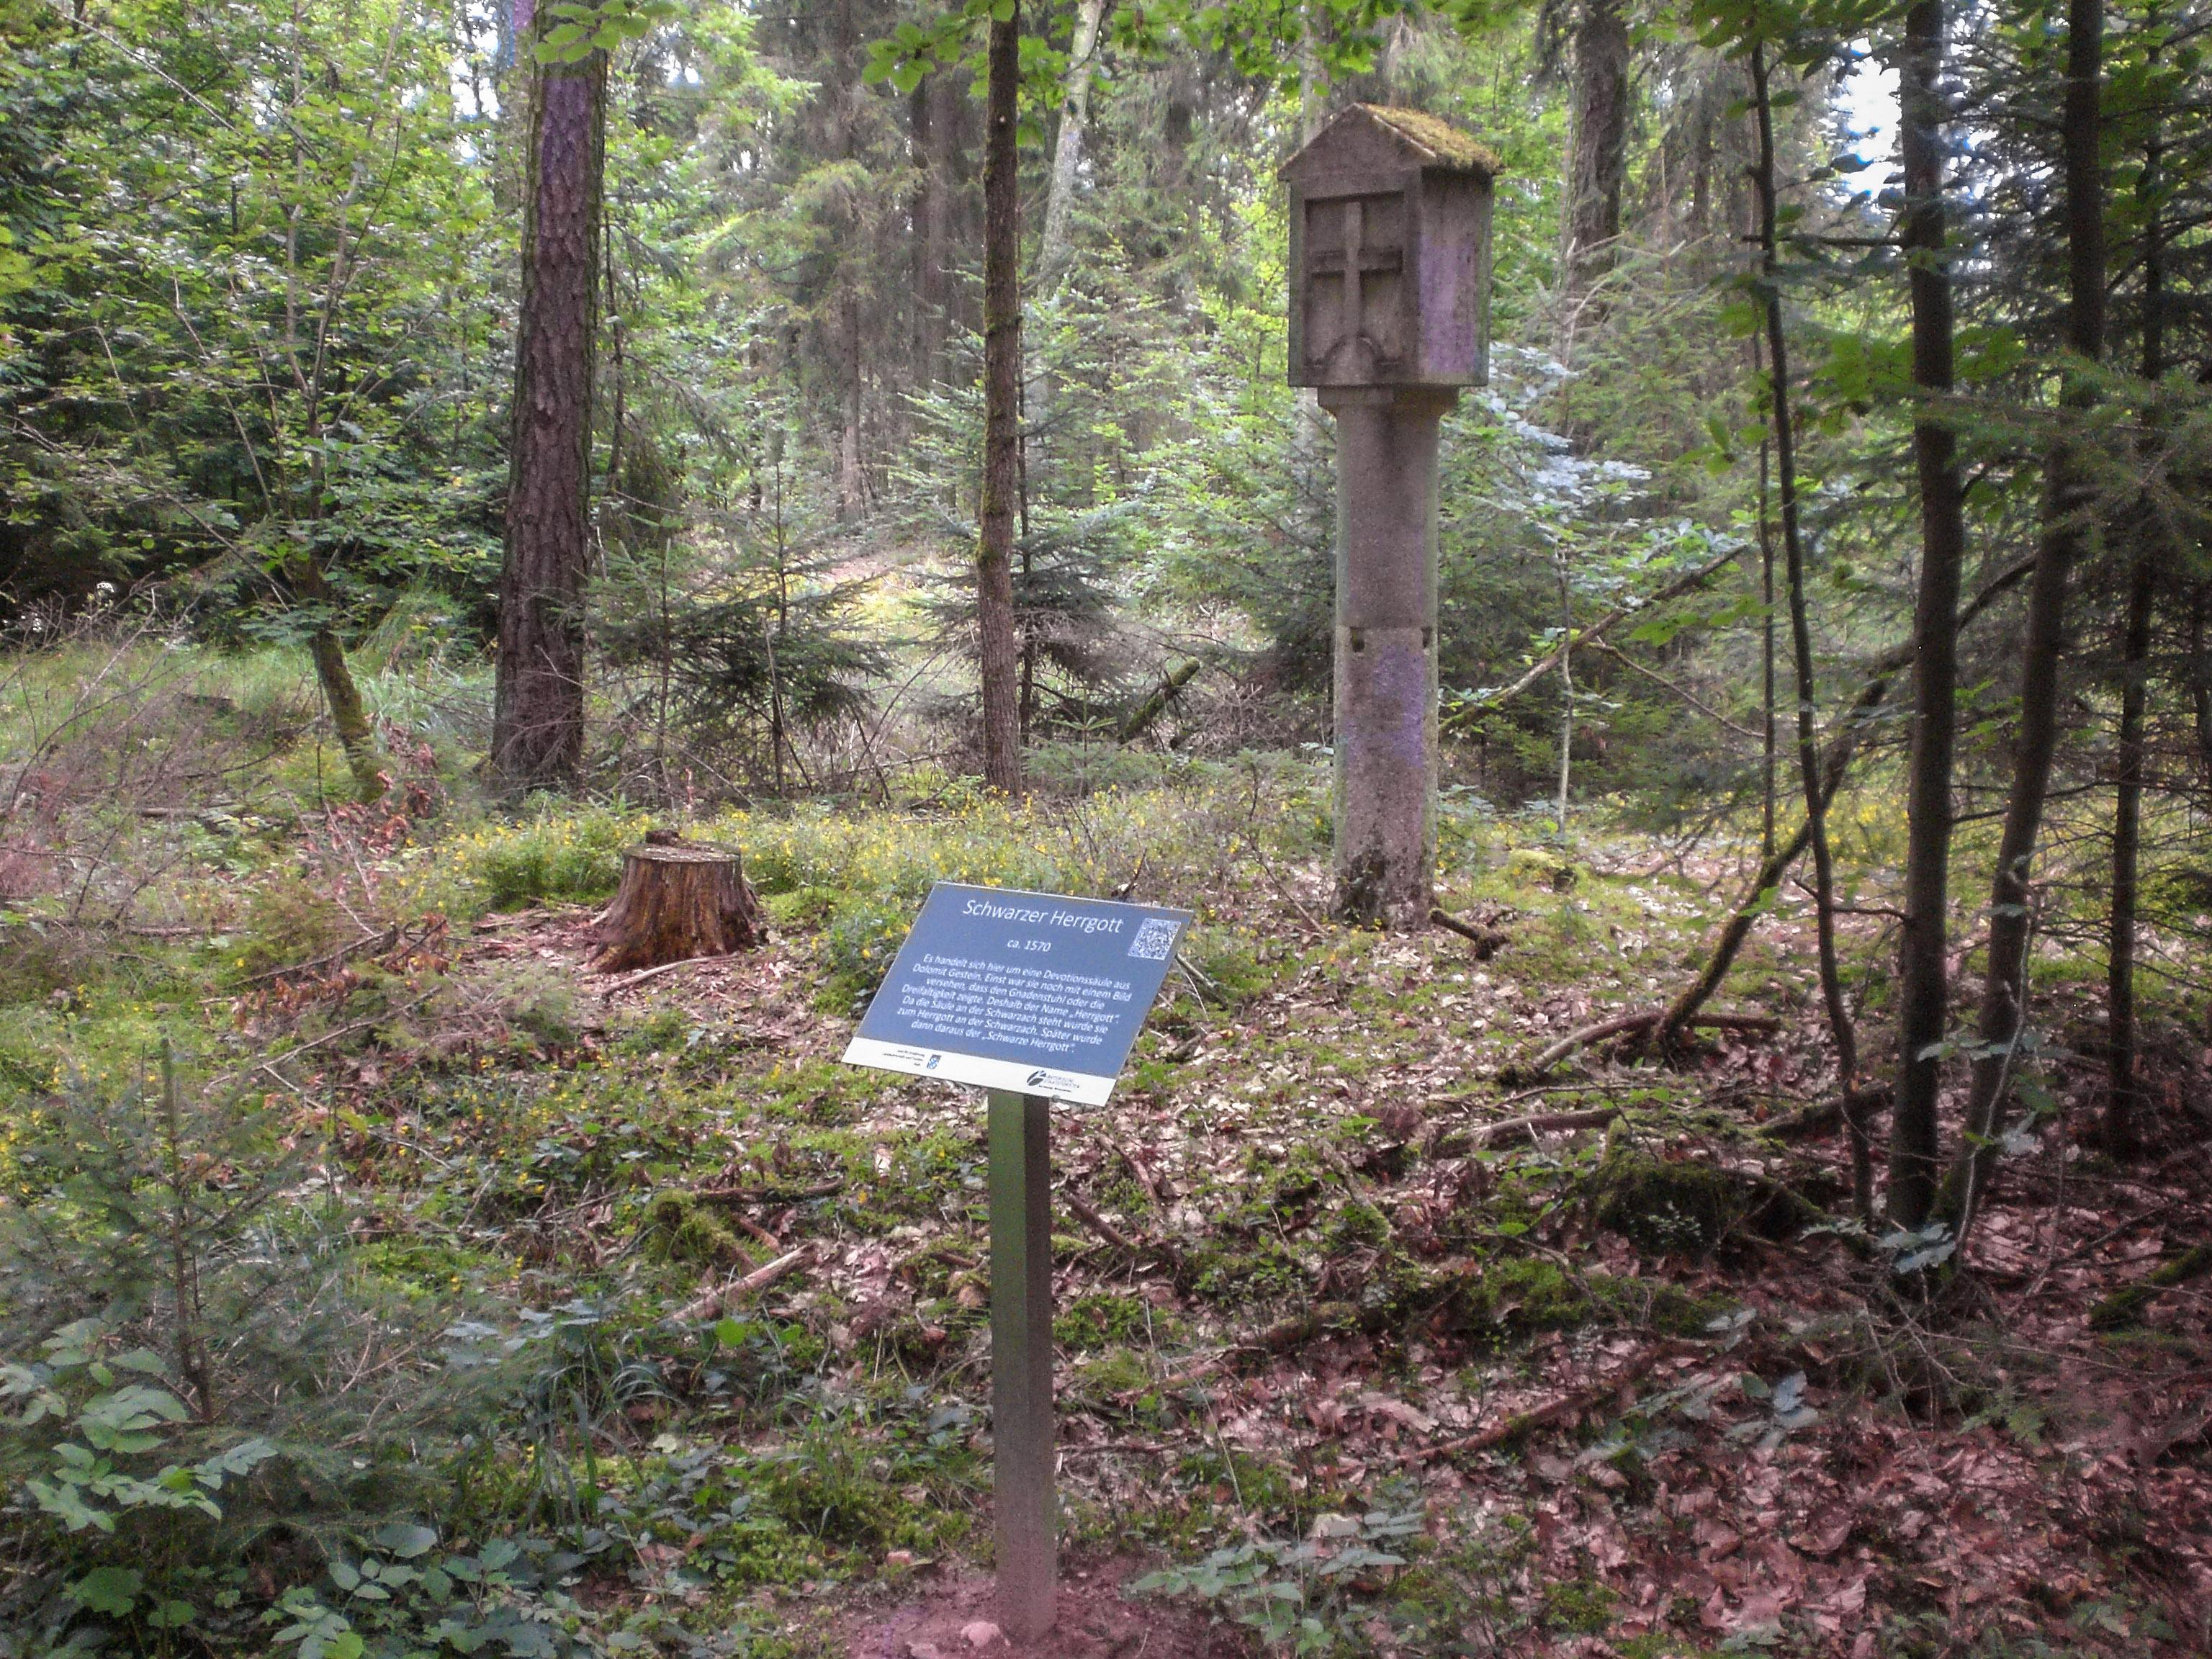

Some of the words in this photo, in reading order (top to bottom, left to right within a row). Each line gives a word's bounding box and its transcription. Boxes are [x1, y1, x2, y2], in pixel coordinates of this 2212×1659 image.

[963, 899, 1048, 922] Schwarzer
[1050, 910, 1123, 933] Herrgott
[1007, 939, 1020, 948] ca.
[1024, 940, 1051, 952] 1570
[913, 963, 947, 976] Dolomit
[949, 968, 981, 980] Gestein.
[985, 973, 1006, 984] Einst
[1026, 979, 1038, 988] sie
[1082, 987, 1110, 997] einem
[1113, 991, 1132, 1002] Bild
[924, 953, 933, 962] Es
[935, 956, 967, 967] handelt
[987, 962, 1004, 971] hier
[1022, 967, 1042, 976] eine
[1114, 981, 1130, 989] aus
[902, 984, 956, 999] Dreifaltigkeit
[957, 993, 982, 1004] zeigte.
[987, 996, 1022, 1009] Deshalb
[1024, 1002, 1039, 1011] der
[1041, 1004, 1068, 1015] Name
[927, 979, 965, 990] versehen,
[969, 982, 987, 992] dass
[990, 985, 1007, 994] den
[1010, 988, 1066, 1003] Gnadenstuhl
[1067, 997, 1088, 1007] oder
[1090, 1000, 1105, 1009] die
[903, 995, 914, 1004] Da
[916, 997, 930, 1007] die
[969, 1005, 984, 1014] der
[986, 1007, 1036, 1022] Schwarzach
[1039, 1017, 1061, 1026] steht
[1064, 1021, 1092, 1030] wurde
[911, 1019, 933, 1030] dann
[935, 1023, 963, 1035] daraus
[966, 1028, 981, 1037] der
[917, 1009, 954, 1022] Herrgott
[968, 1017, 984, 1025] der
[985, 1019, 1037, 1035] Schwarzach.
[1041, 1027, 1071, 1039] Später
[1073, 1034, 1102, 1045] wurde
